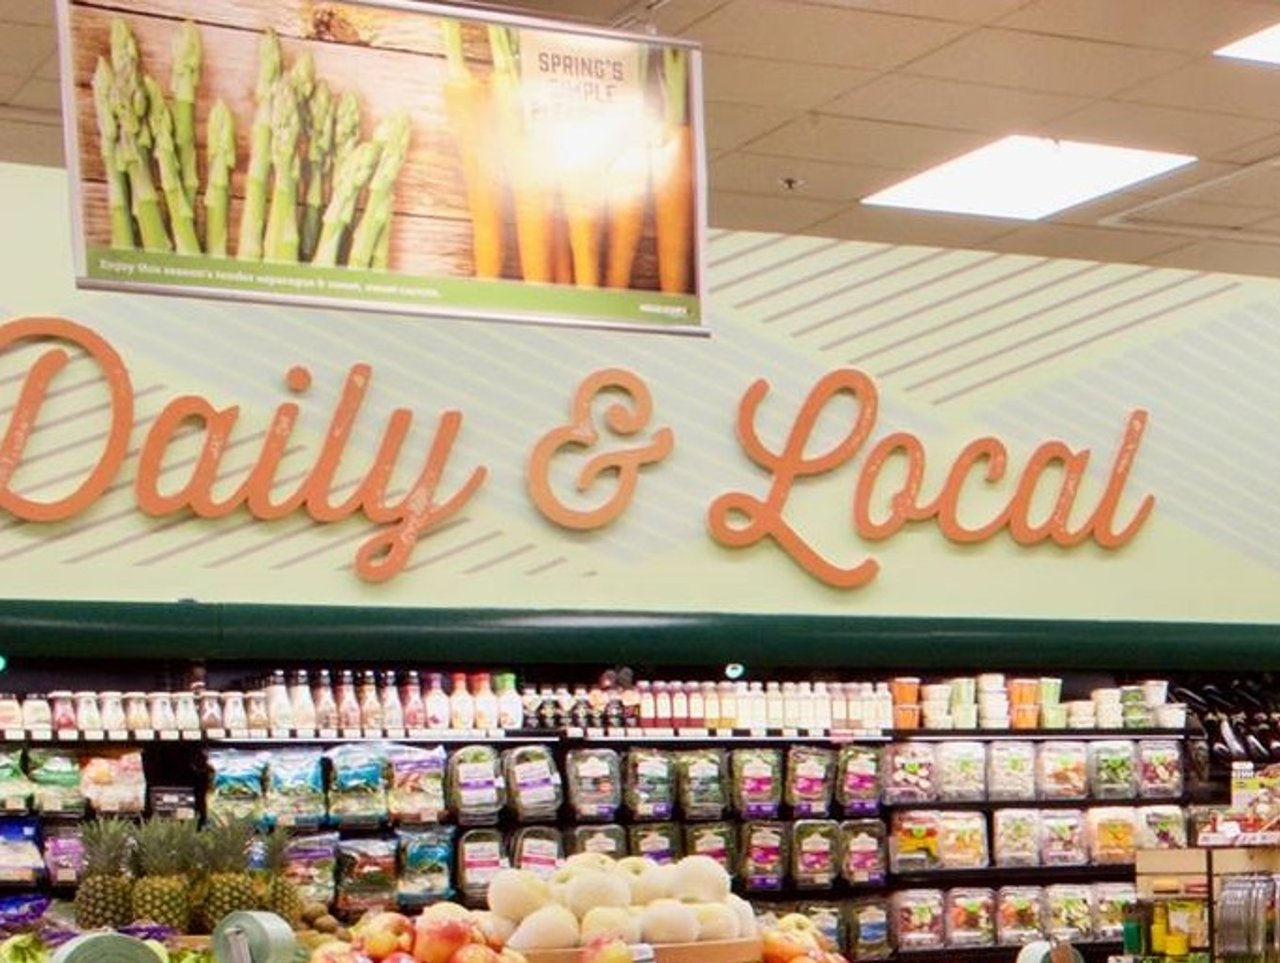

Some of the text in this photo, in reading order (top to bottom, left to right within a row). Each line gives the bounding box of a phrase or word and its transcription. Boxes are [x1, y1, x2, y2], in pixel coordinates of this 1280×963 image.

[538, 51, 624, 82] SPRING'S
[0, 316, 1156, 590] Daily & Local
